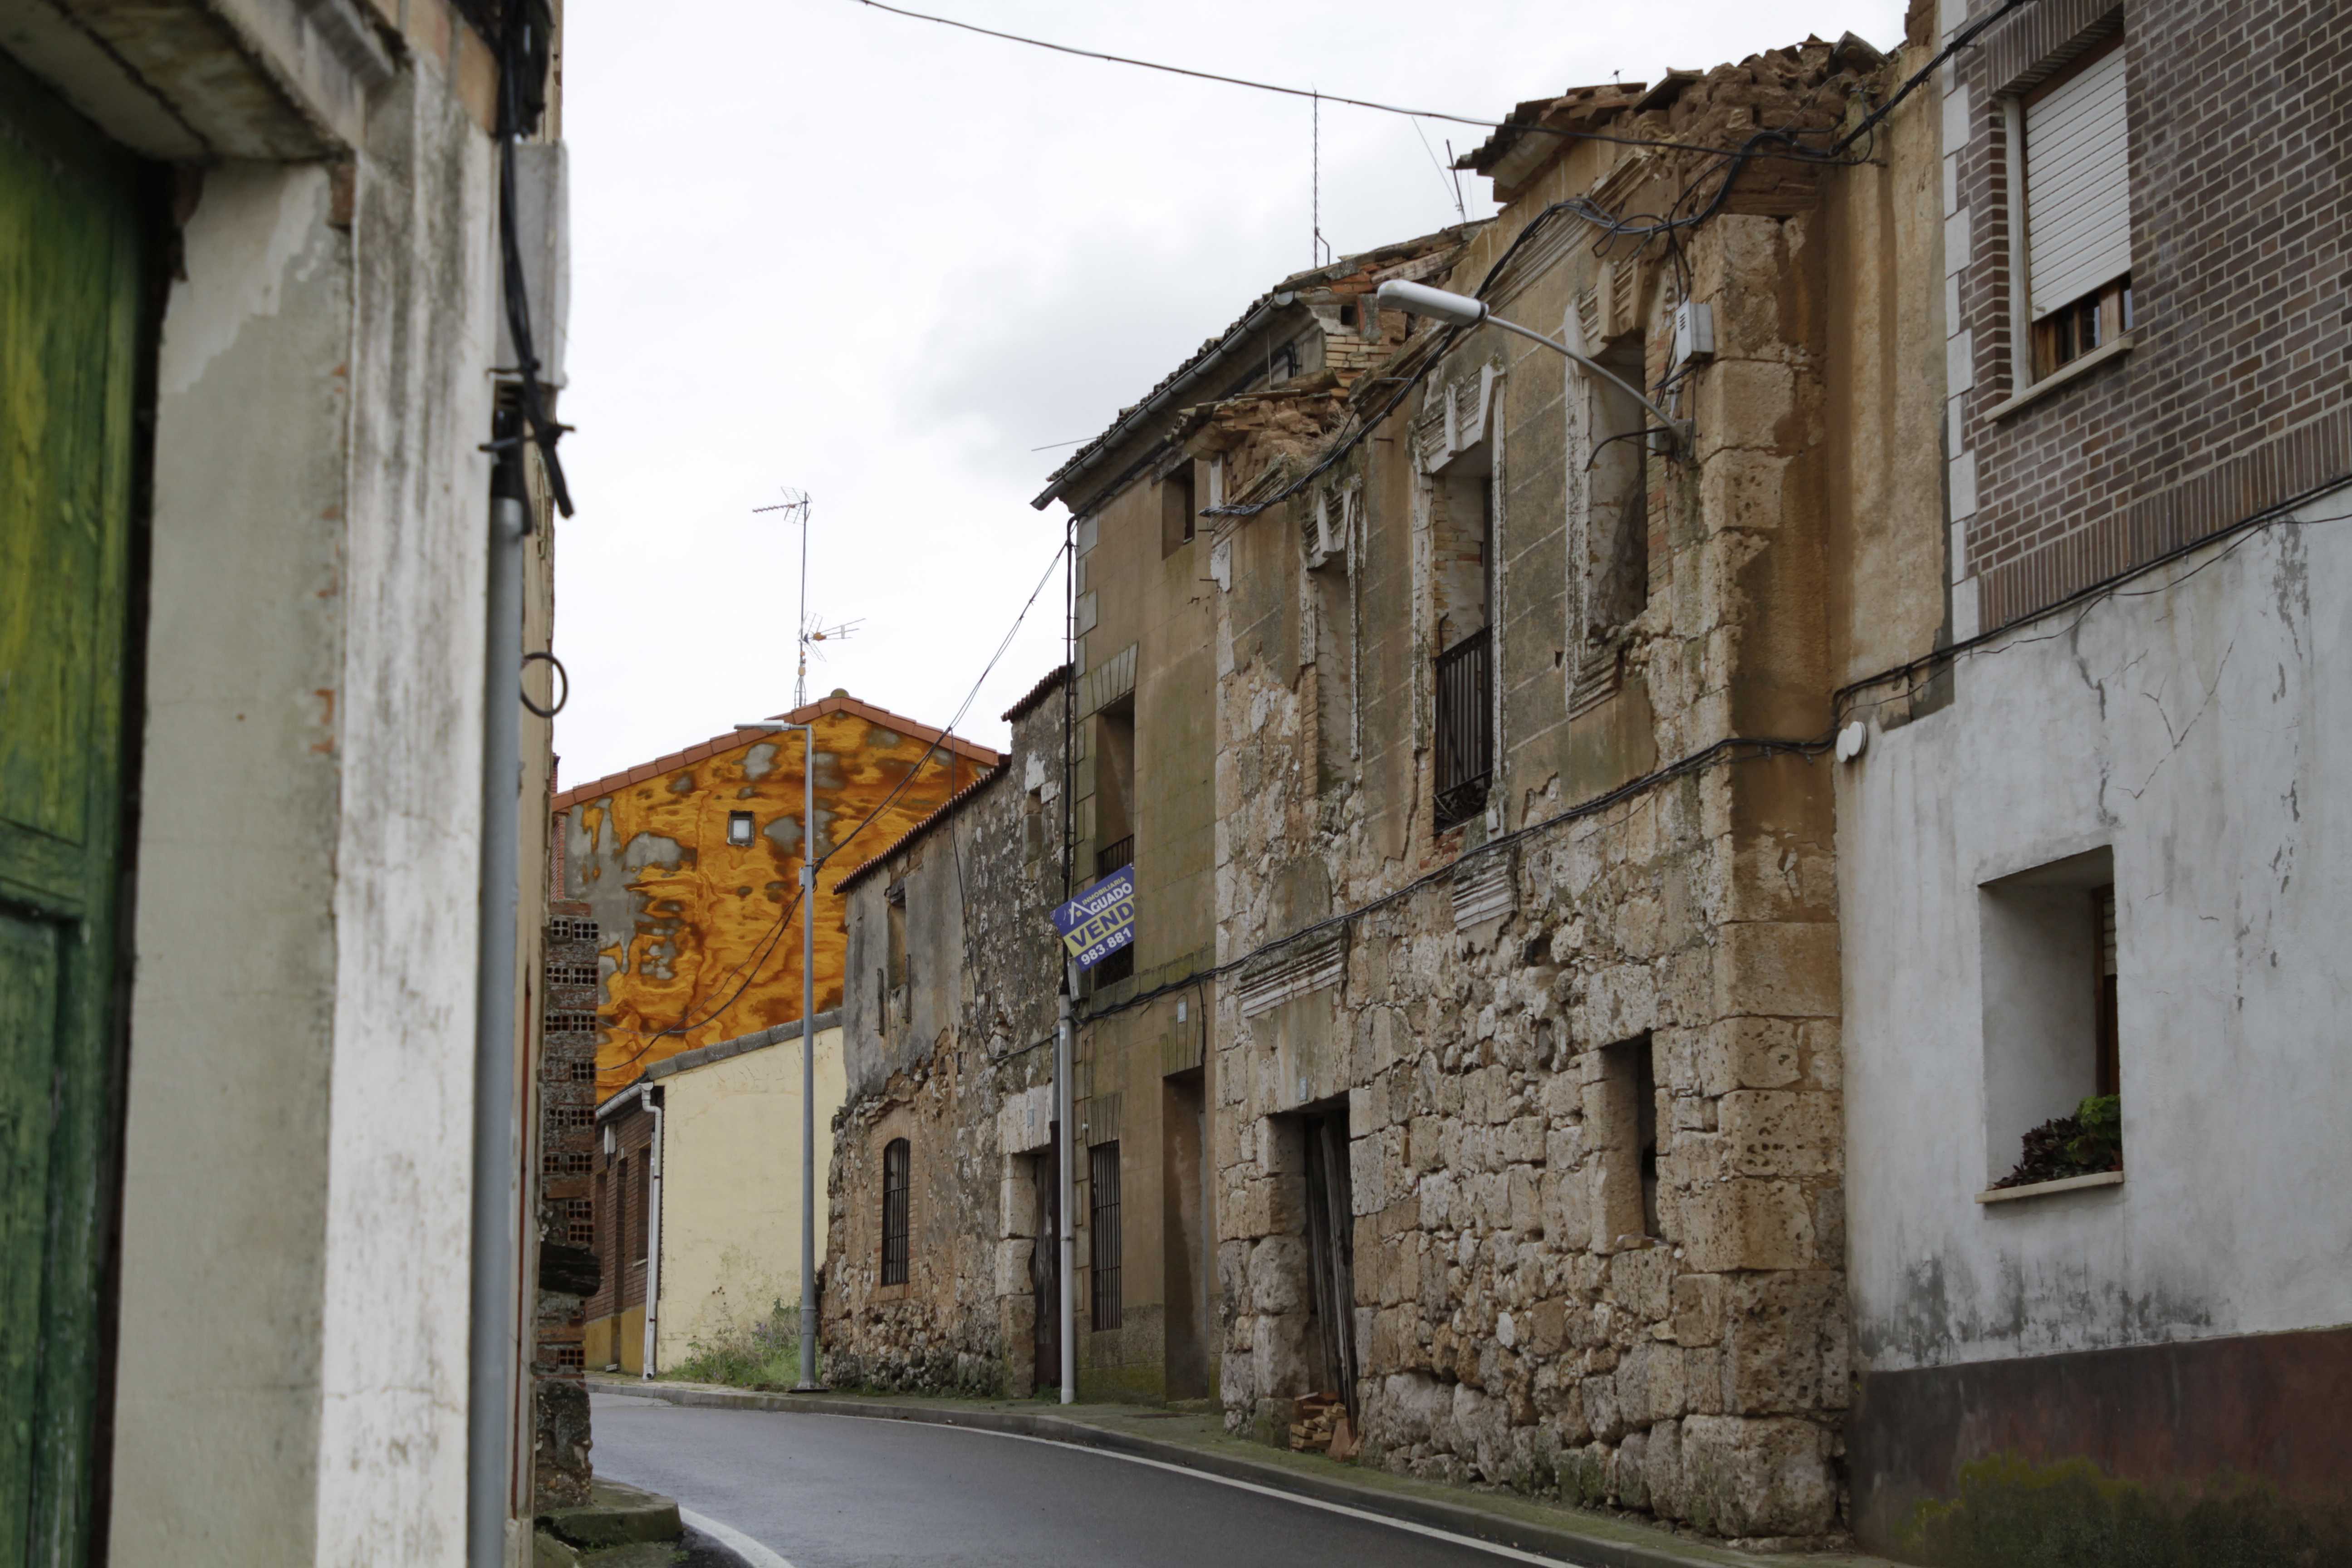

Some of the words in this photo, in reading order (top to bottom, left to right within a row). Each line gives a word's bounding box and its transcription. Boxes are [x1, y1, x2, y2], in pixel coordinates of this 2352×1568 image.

[1070, 882, 1132, 925] AGUADO
[1082, 877, 1126, 905] INMOBILIARIA
[1070, 898, 1134, 947] VEND
